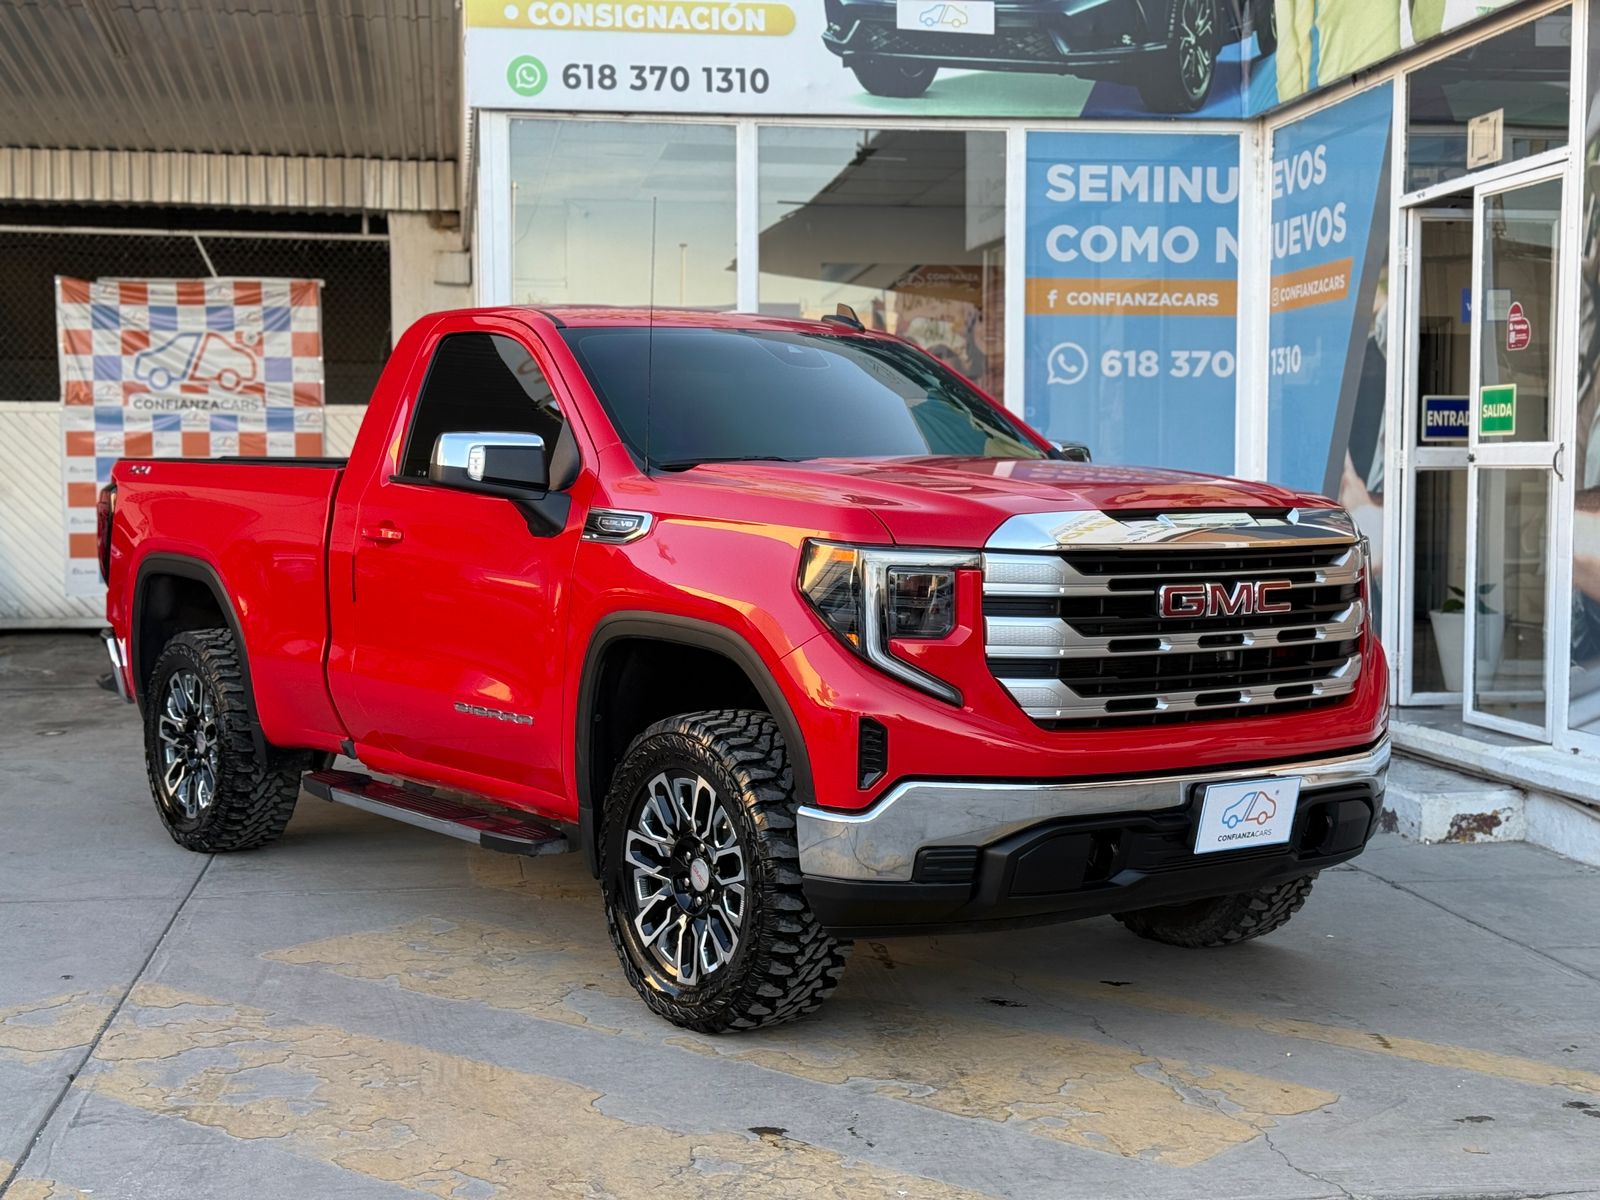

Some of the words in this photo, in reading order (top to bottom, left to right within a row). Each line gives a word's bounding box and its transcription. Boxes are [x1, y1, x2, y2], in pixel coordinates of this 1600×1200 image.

[527, 1, 766, 32] CONSIGNACIÓN
[562, 63, 617, 91] 618
[629, 65, 690, 92] 370
[702, 67, 770, 94] 1310
[1045, 224, 1199, 263] COMO
[1066, 291, 1219, 307] CONFIANZACARS
[1280, 274, 1345, 302] CONFIANZACARS
[1101, 350, 1159, 378] 618
[1169, 350, 1235, 378] 370
[1271, 344, 1301, 375] 1310
[133, 399, 259, 411] CONFIANZACARS
[1482, 403, 1512, 418] SALIDA
[1159, 580, 1292, 618] GMC
[1217, 828, 1272, 842] CONFIANZACARS
